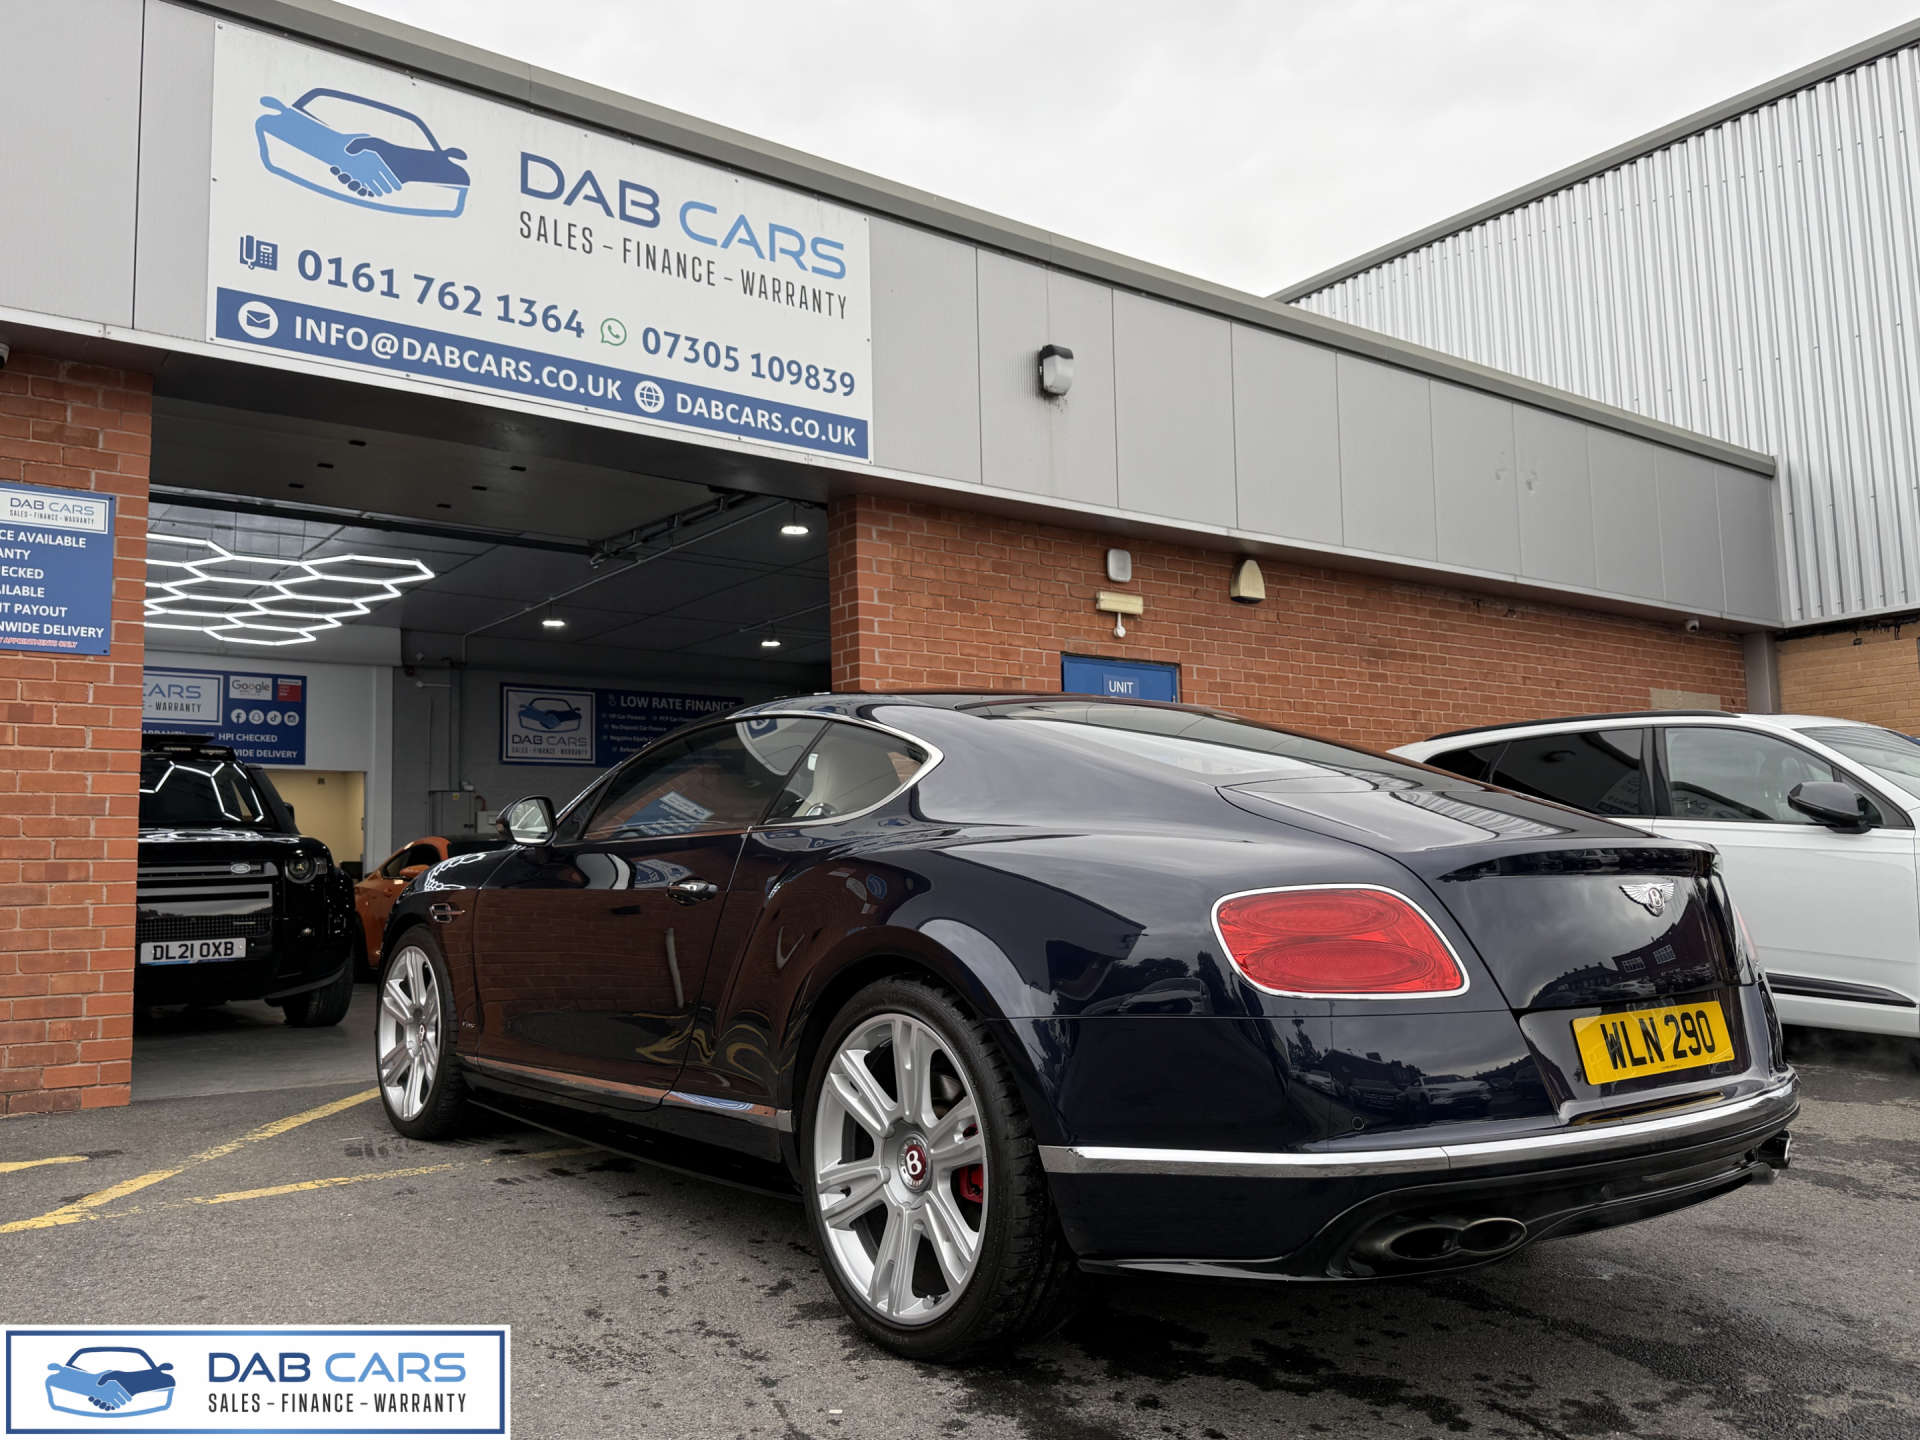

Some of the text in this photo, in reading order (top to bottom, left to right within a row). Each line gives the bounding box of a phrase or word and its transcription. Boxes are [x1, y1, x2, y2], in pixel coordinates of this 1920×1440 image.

[521, 152, 847, 280] DAB CARS
[519, 210, 593, 255] SALES
[623, 237, 716, 287] FINANCE
[740, 268, 847, 320] WARRANTY
[297, 249, 585, 339] 0161 762 1364
[294, 315, 623, 402] INFO@DABCARS.CO.UK
[641, 326, 856, 397] 07305 109839
[675, 392, 857, 447] DABCARS.CO.UK
[10, 497, 95, 517] DAB CARS
[17, 531, 87, 549] AVAILABLE
[0, 583, 46, 598] ILABLE
[14, 603, 68, 619] PAYOUT
[43, 623, 105, 639] DELIVERY
[232, 679, 270, 692] Google
[1108, 679, 1134, 694] UNIT
[155, 700, 202, 713] WARRANTY
[620, 695, 649, 708] LOW
[652, 697, 682, 710] RATE
[218, 733, 278, 743] HPI CHECKED
[256, 749, 298, 759] DELIVERY
[152, 940, 235, 961] DL21 OXB
[1600, 1009, 1716, 1070] WLN 290
